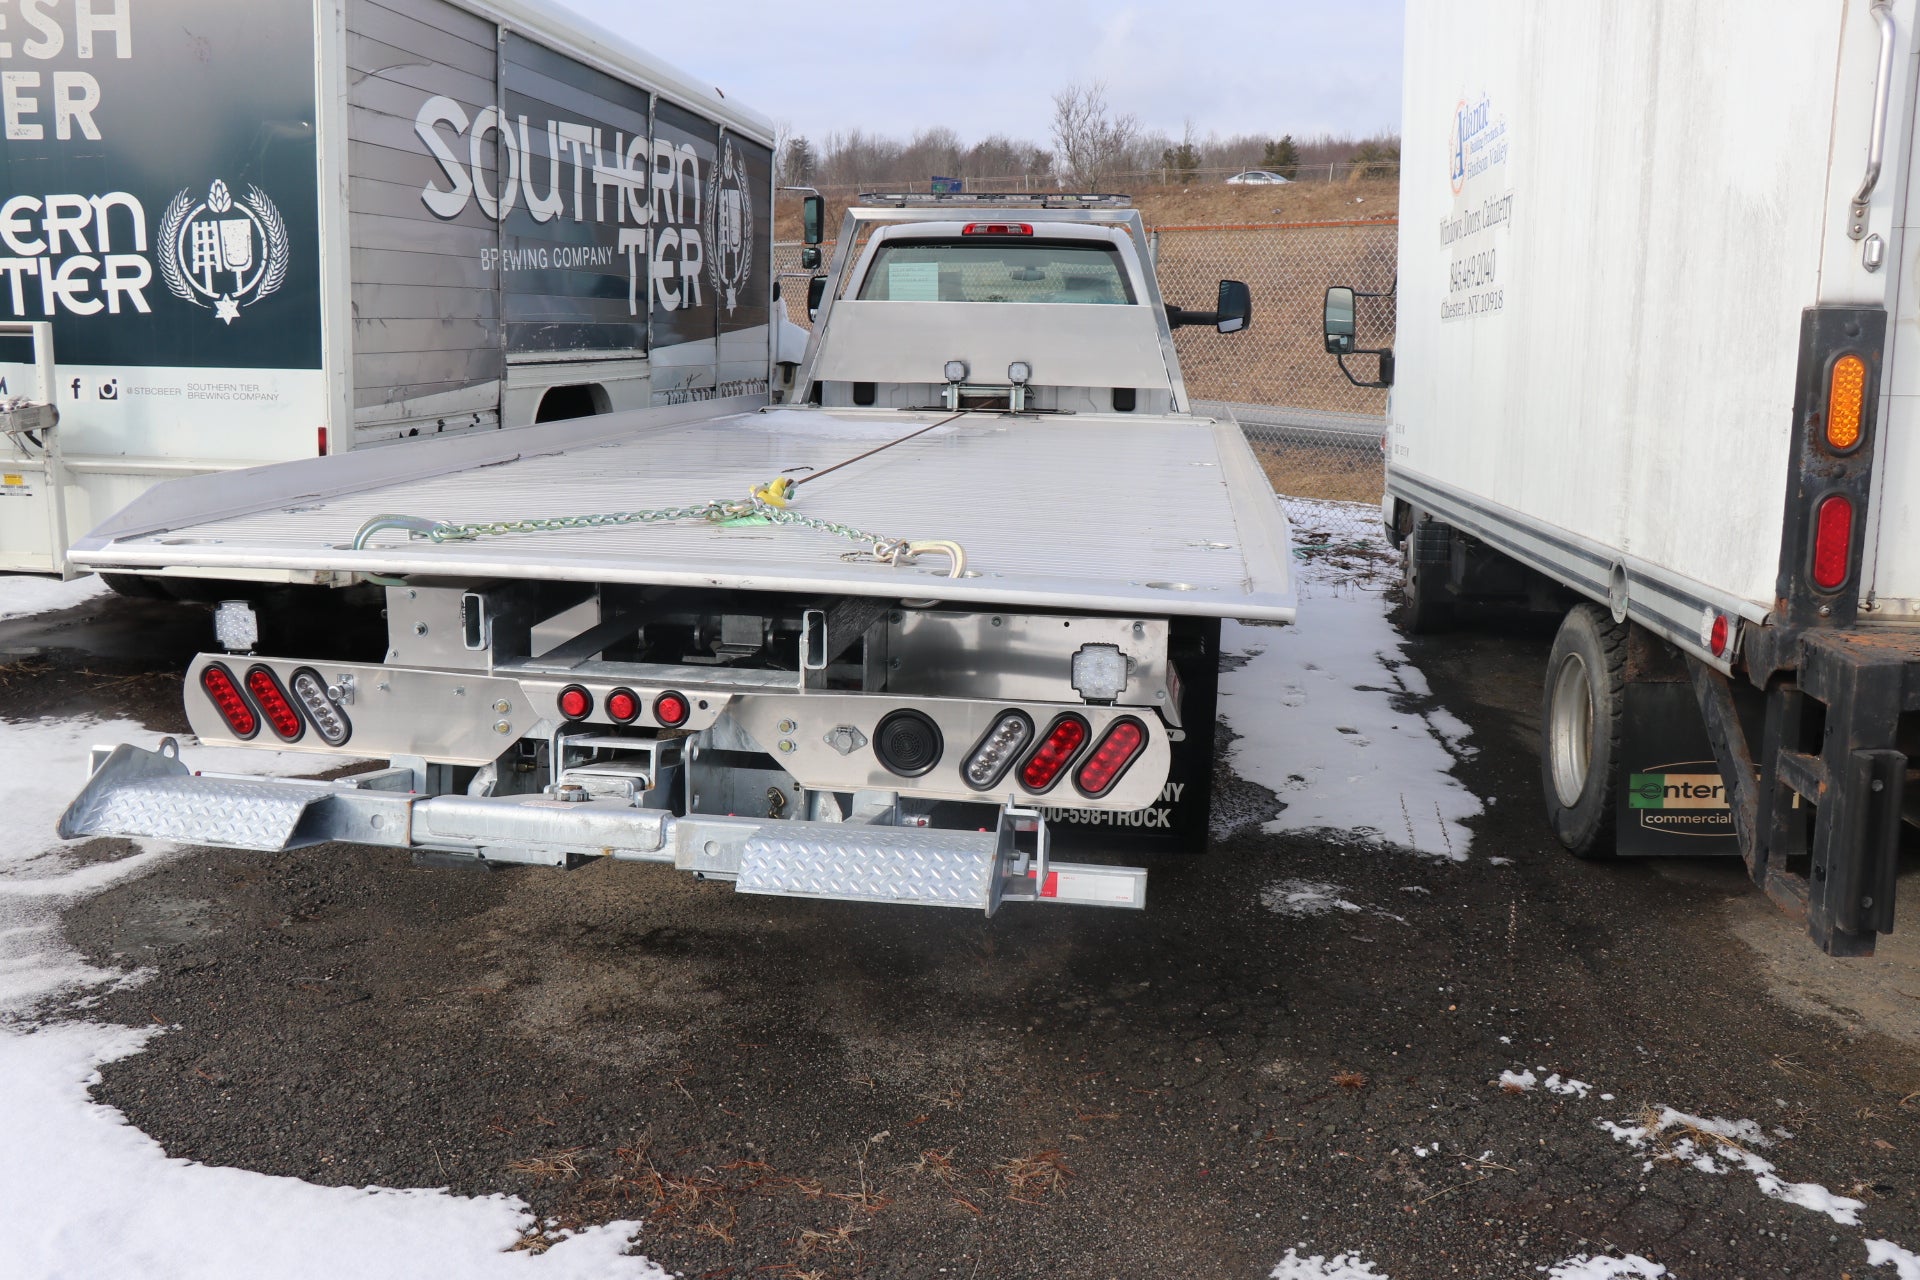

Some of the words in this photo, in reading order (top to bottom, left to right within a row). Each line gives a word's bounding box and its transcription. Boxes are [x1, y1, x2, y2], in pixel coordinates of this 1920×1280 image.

[414, 95, 701, 225] SOUTHERN
[480, 247, 549, 272] BREWING
[552, 246, 613, 269] COMPANY
[618, 227, 704, 316] TIER
[0, 254, 153, 316] TIER
[1468, 295, 1480, 315] NY
[1480, 289, 1504, 312] 10918
[187, 382, 238, 392] SOUTHERN
[239, 383, 260, 392] TIER
[187, 391, 231, 400] BREWING
[232, 392, 280, 401] COMPANY
[1637, 781, 1732, 804] enter
[1645, 812, 1733, 825] commercial
